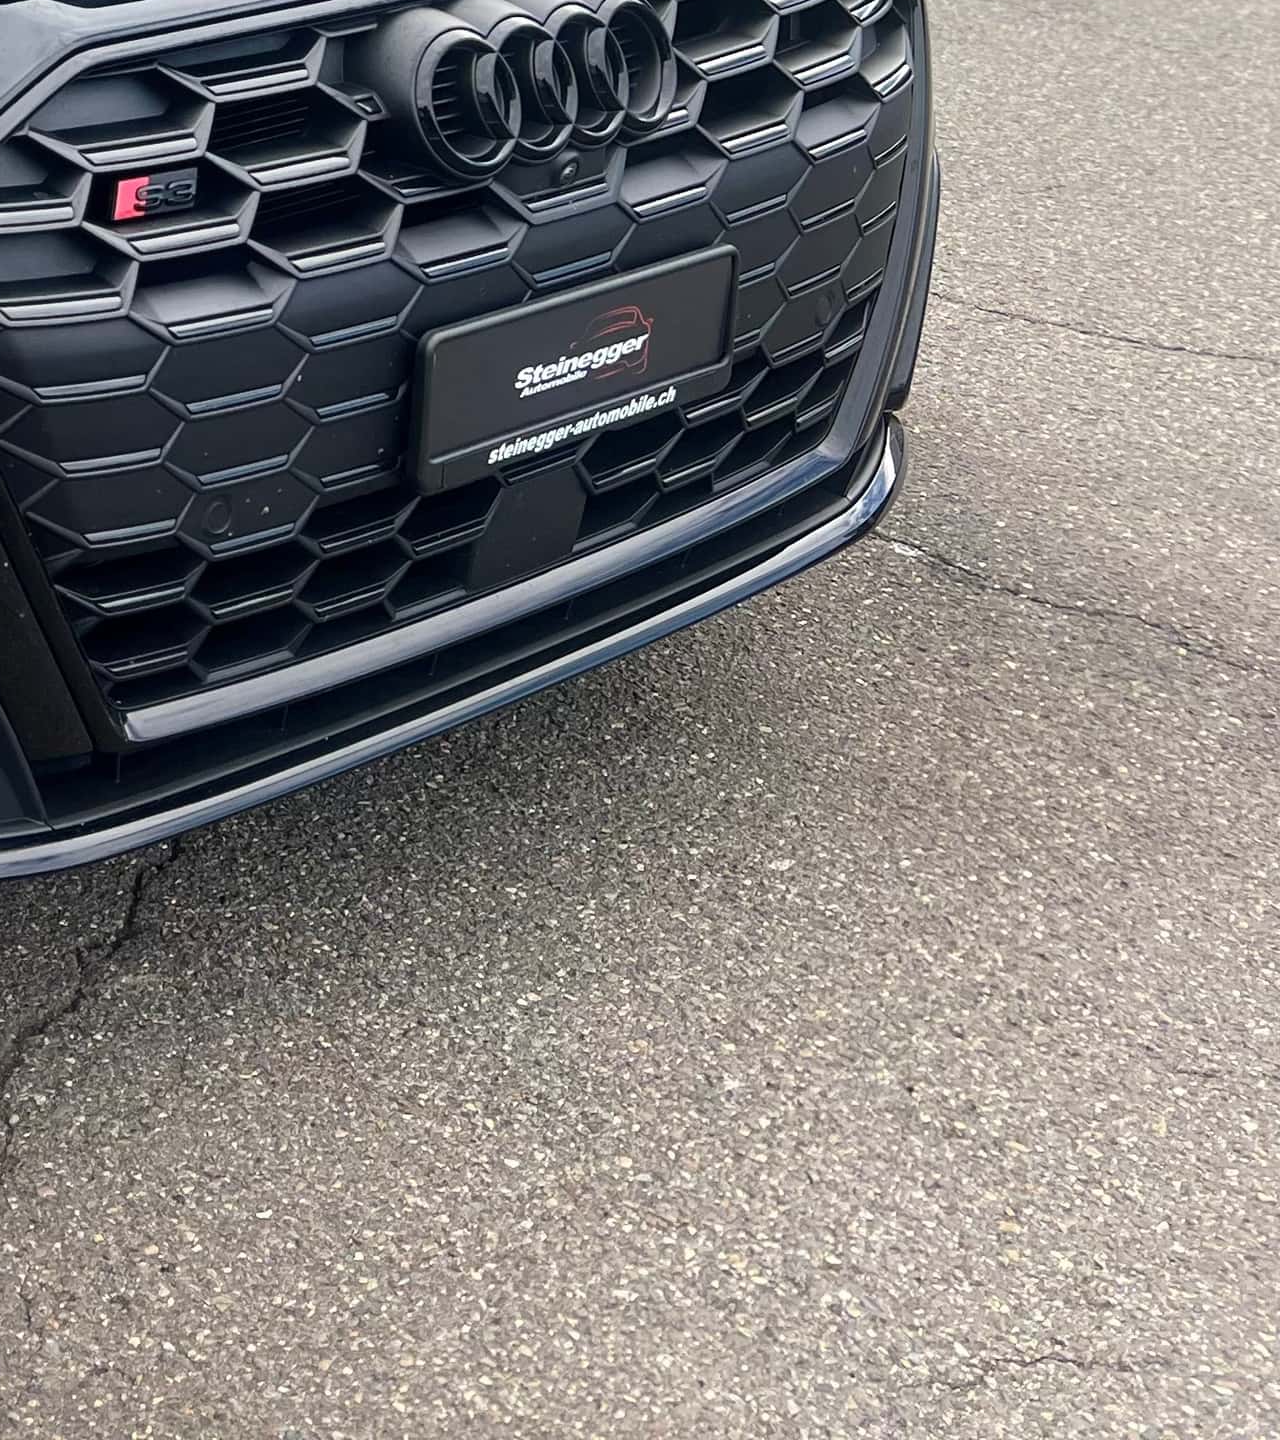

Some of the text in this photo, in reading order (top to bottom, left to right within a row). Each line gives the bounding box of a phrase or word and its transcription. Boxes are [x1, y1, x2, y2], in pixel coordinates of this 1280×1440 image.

[133, 178, 197, 212] S3
[514, 334, 649, 389] Steinegger
[519, 370, 587, 398] Automobile
[488, 386, 677, 464] steinegger-automobile.ch
